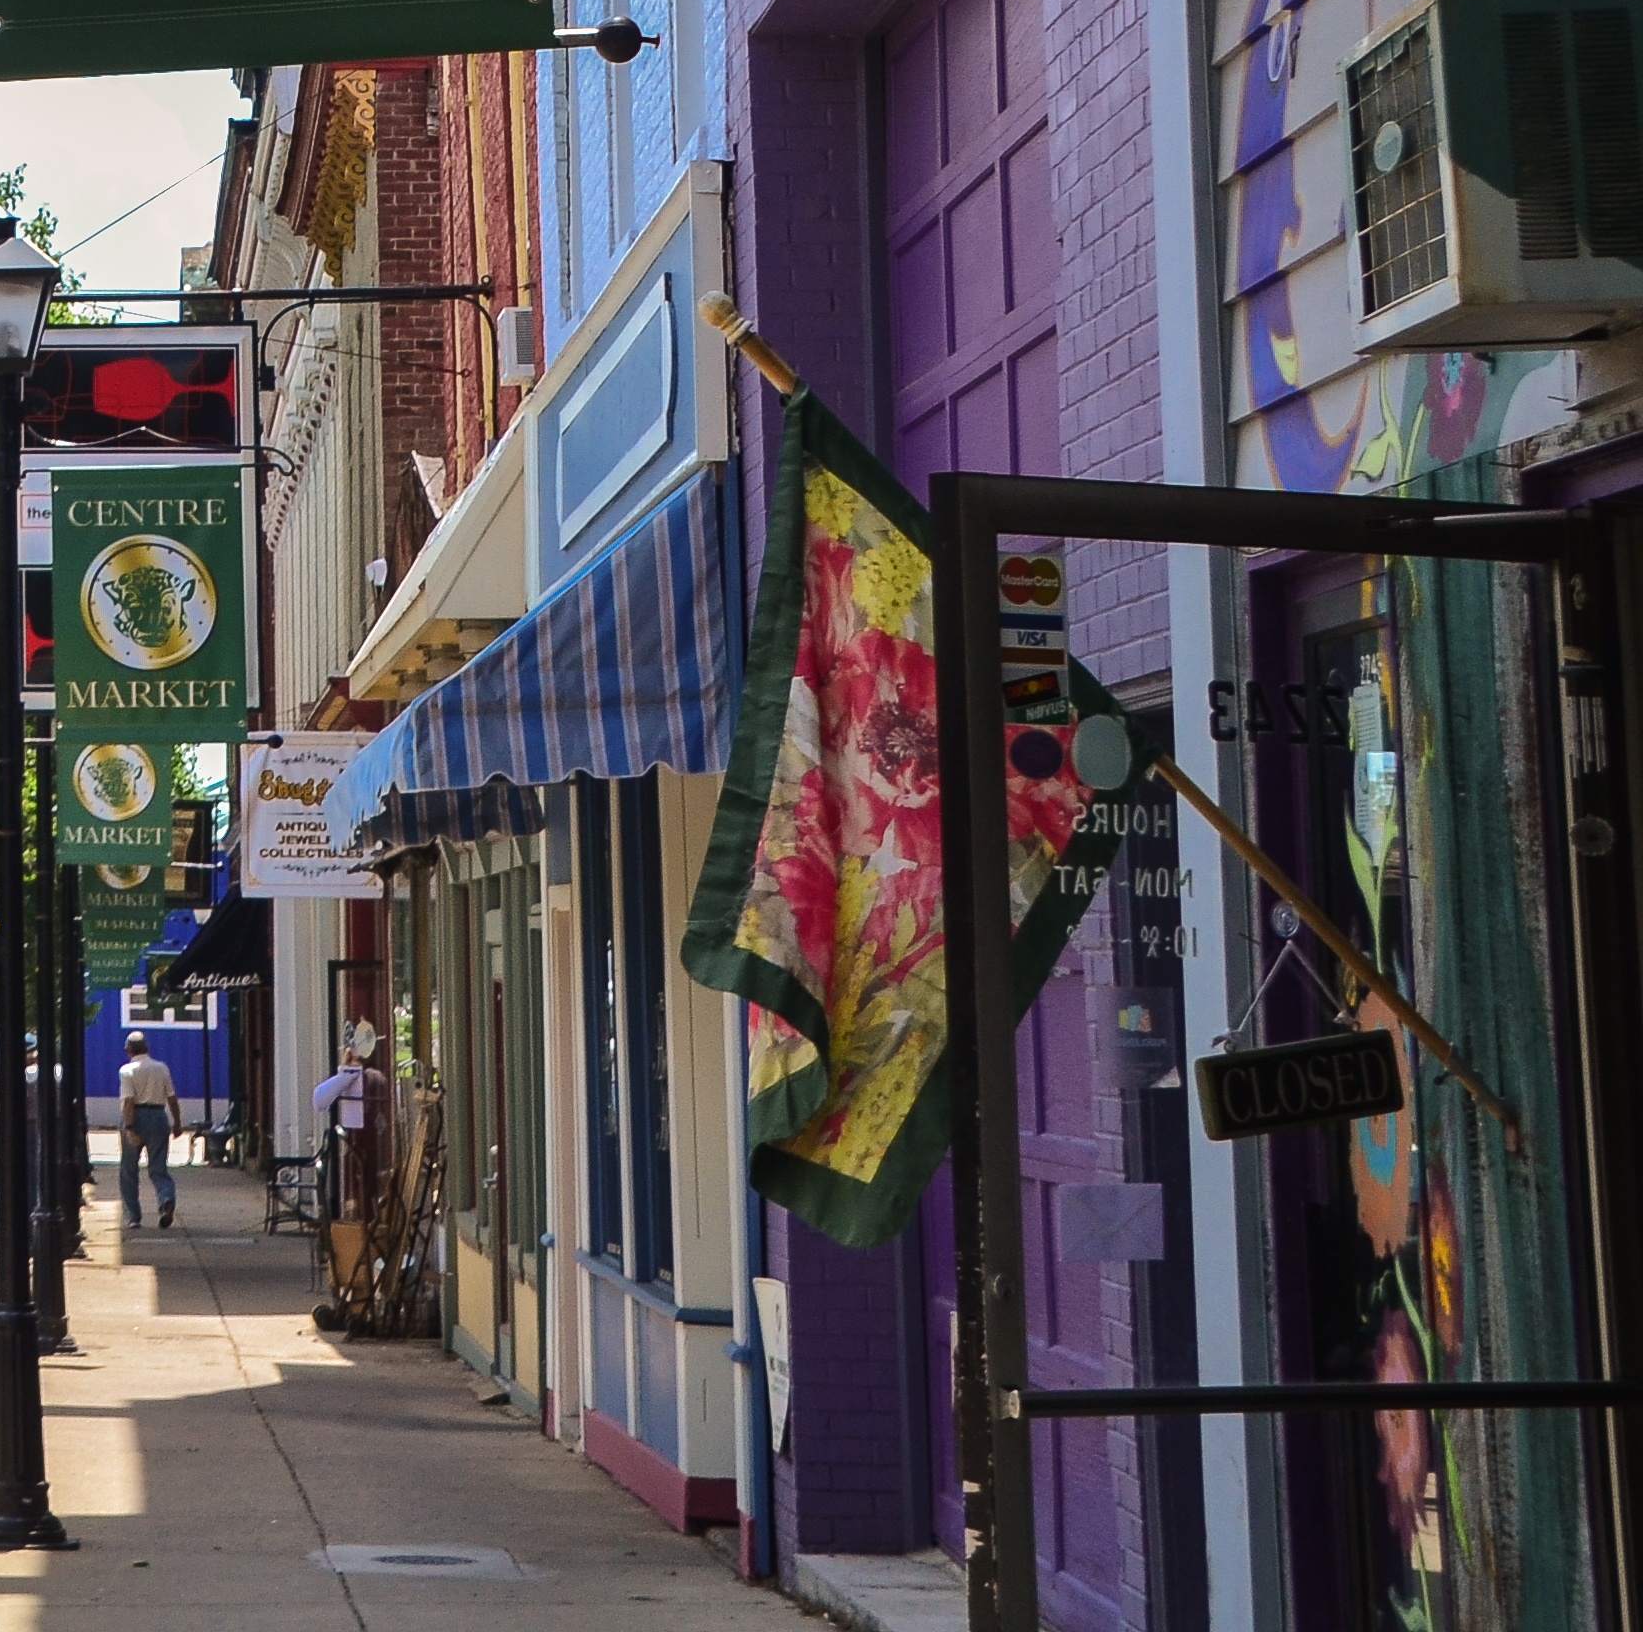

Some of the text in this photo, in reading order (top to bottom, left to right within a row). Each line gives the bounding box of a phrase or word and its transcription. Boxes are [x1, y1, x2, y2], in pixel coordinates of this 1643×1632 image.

[67, 498, 228, 527] CENTRE
[1000, 573, 1060, 588] MasterCard
[1016, 630, 1048, 647] VISA
[66, 679, 236, 709] MARKET
[64, 825, 166, 845] MARKET
[275, 821, 328, 832] ANTIQU
[277, 835, 332, 845] JEWEL
[87, 892, 159, 908] MARKET
[177, 970, 262, 990] Antiques
[1221, 1048, 1390, 1124] CLOSED
